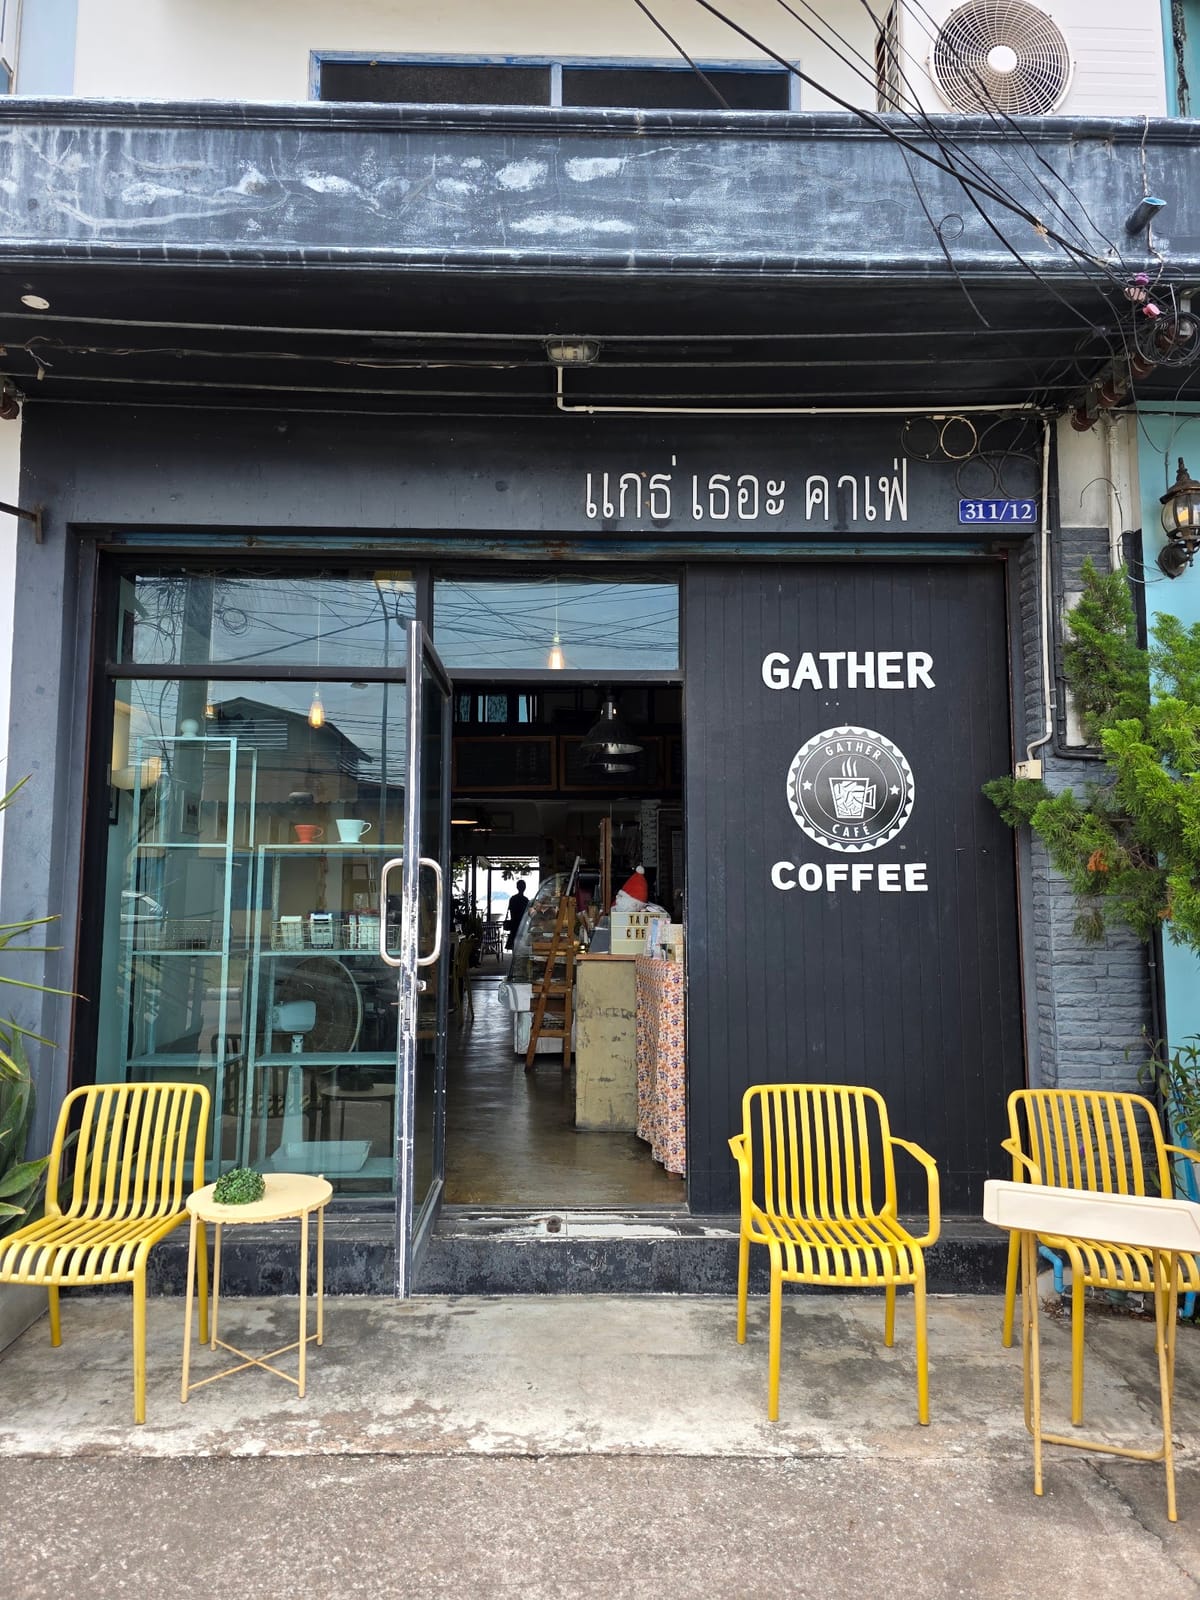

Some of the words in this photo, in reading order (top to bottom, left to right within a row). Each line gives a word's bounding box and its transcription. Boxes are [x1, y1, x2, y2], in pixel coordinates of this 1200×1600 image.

[691, 473, 786, 520] เธอะ
[805, 458, 908, 521] คาเฟ่
[965, 502, 1032, 520] 311/12
[761, 651, 936, 690] GATHER
[825, 741, 882, 761] GATHER
[771, 861, 929, 892] COFFEE
